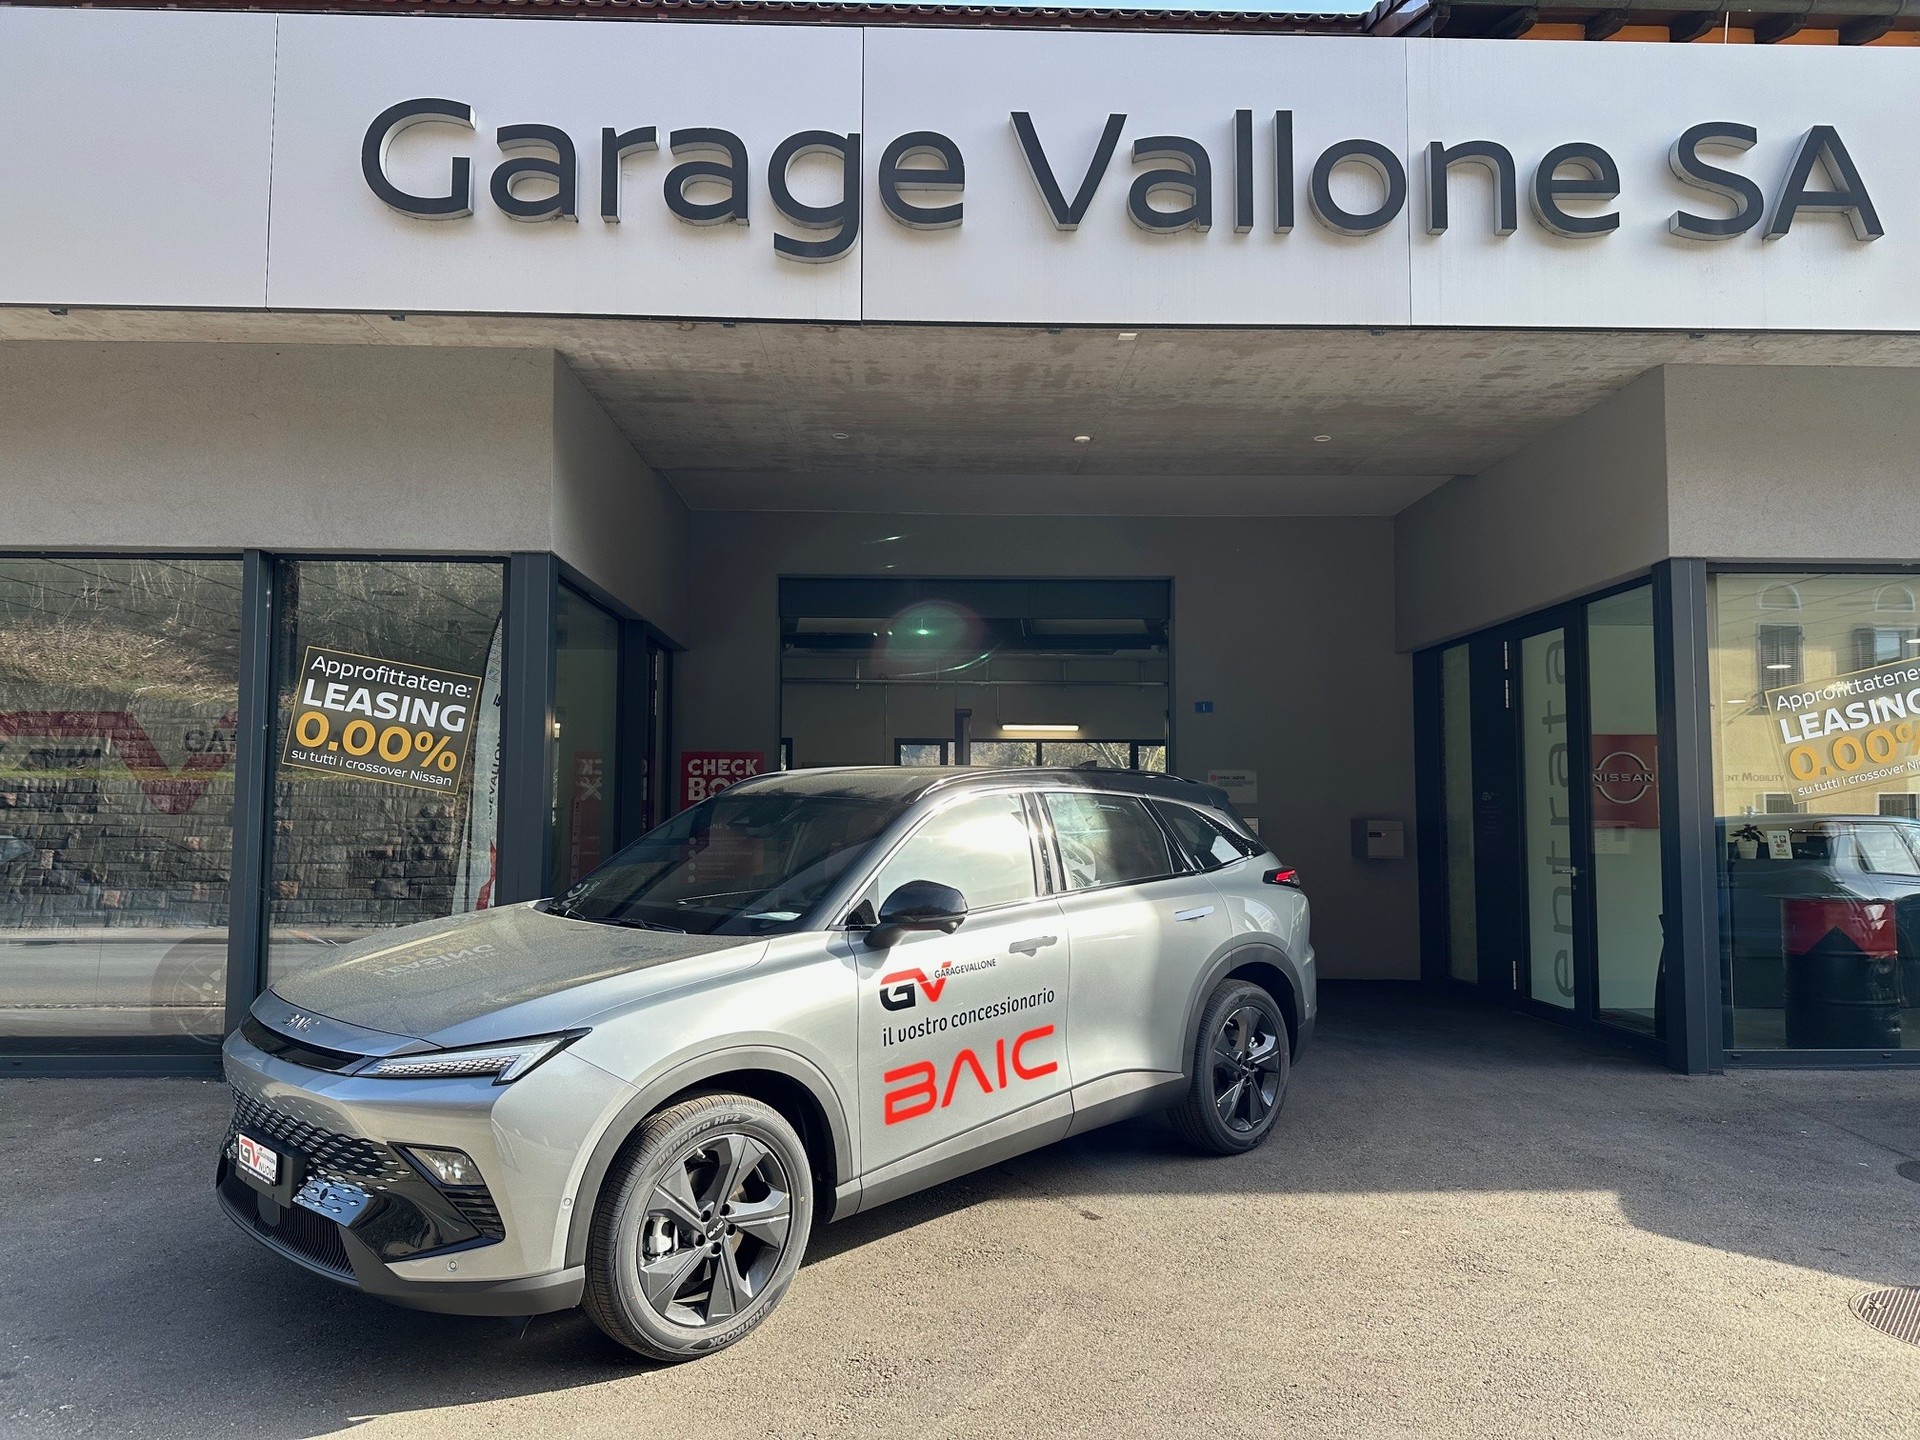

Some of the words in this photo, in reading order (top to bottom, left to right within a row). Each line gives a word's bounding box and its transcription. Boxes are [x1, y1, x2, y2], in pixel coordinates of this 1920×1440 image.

[361, 98, 966, 264] Garage
[1009, 109, 1621, 237] Vallone
[1668, 122, 1885, 242] SA
[310, 655, 473, 698] Approfittatene:
[302, 678, 467, 732] LEASING
[295, 711, 457, 772] 0.00%
[290, 749, 307, 761] su
[309, 751, 338, 766] tutti
[339, 756, 344, 767] i
[345, 759, 408, 778] crossover
[410, 769, 453, 787] Nissan
[687, 758, 759, 776] CHECK
[1592, 773, 1655, 783] NISSAN
[1797, 785, 1813, 796] su
[1814, 777, 1840, 791] tutti
[1848, 763, 1904, 785] crossover
[687, 777, 743, 801] BO
[1542, 639, 1575, 999] entrata
[879, 960, 952, 1012] GV
[934, 958, 997, 979] GARAGEVALLONE
[883, 1027, 894, 1047] il
[898, 1017, 948, 1043] vostro
[951, 987, 1055, 1028] concessionario
[883, 1024, 1058, 1126] BAIC
[714, 1113, 741, 1125] HP2
